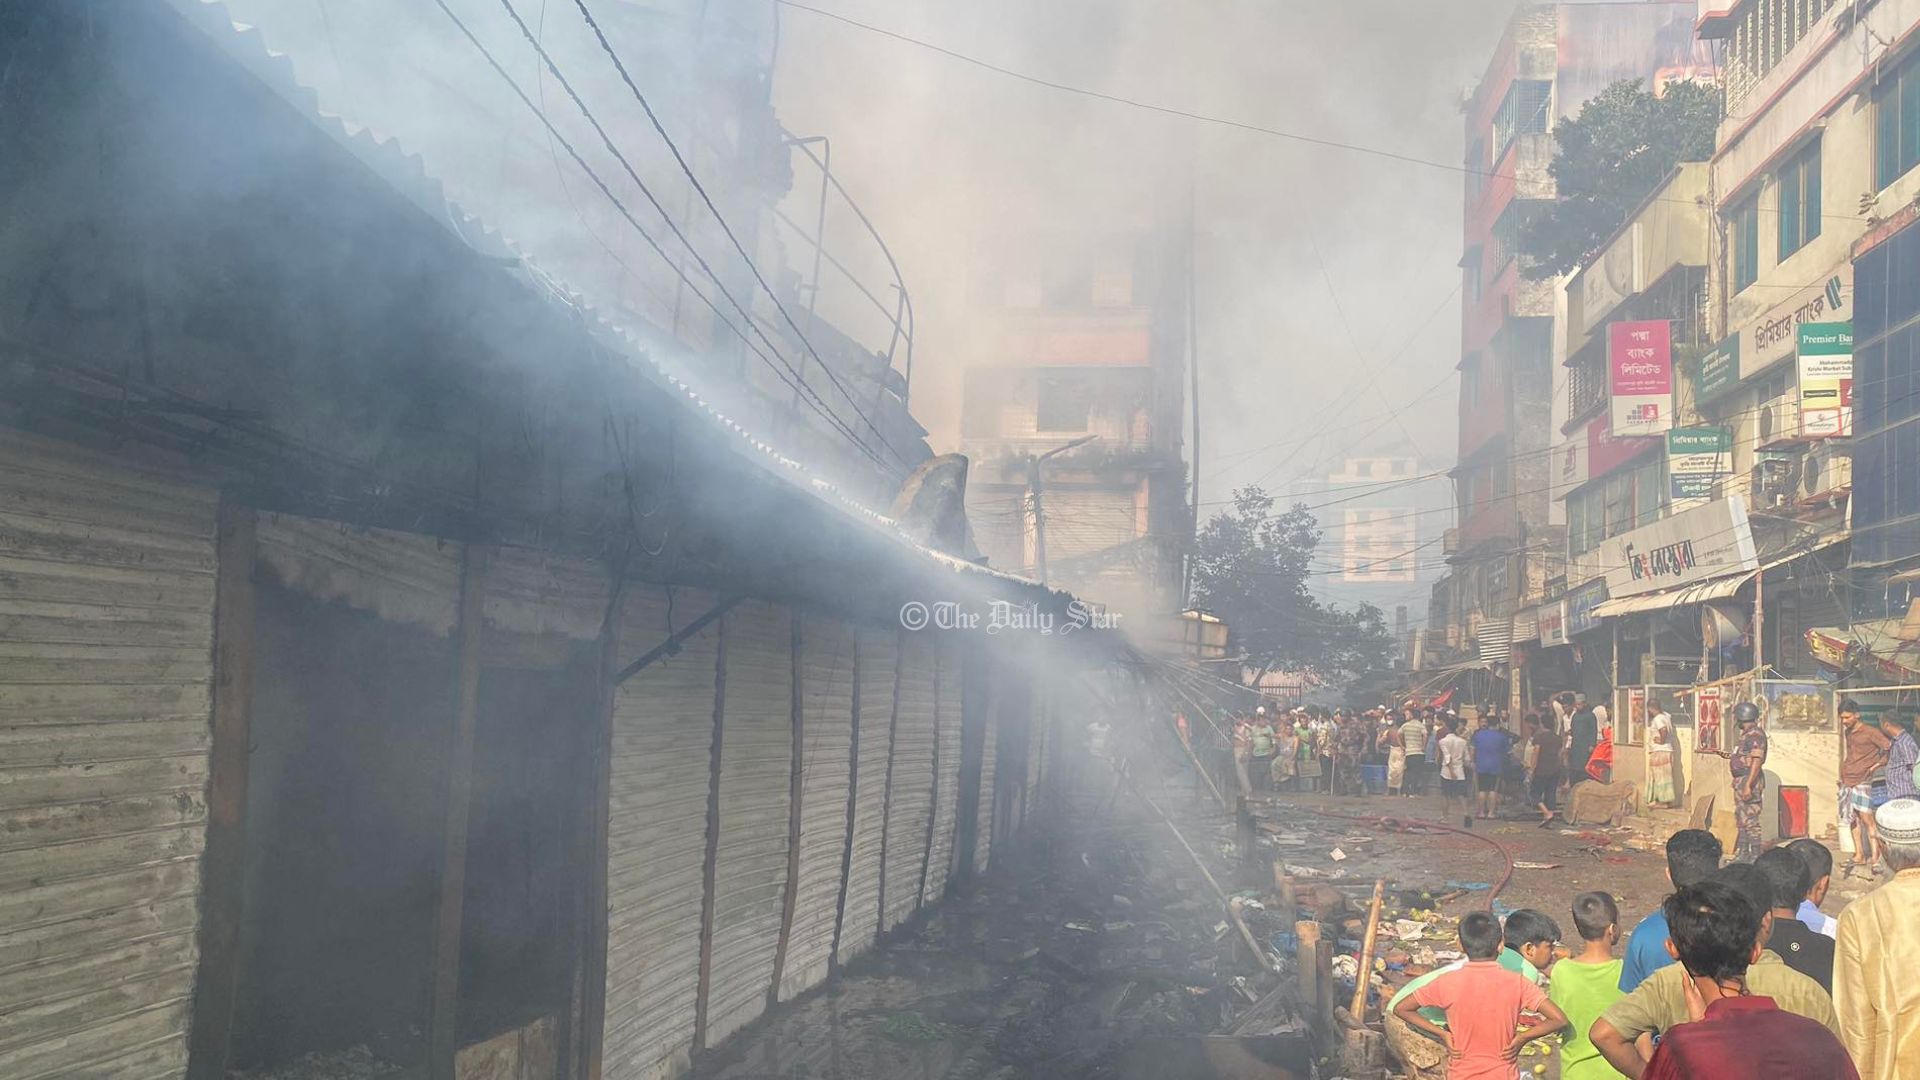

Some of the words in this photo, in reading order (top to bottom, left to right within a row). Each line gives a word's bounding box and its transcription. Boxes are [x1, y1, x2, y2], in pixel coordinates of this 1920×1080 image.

[1630, 330, 1650, 342] পদ্মা
[1755, 315, 1792, 353] প্রিমিয়ার
[1802, 335, 1837, 344] Premier
[1625, 347, 1657, 359] ব্যাংক
[1620, 361, 1662, 376] লিমিটেড
